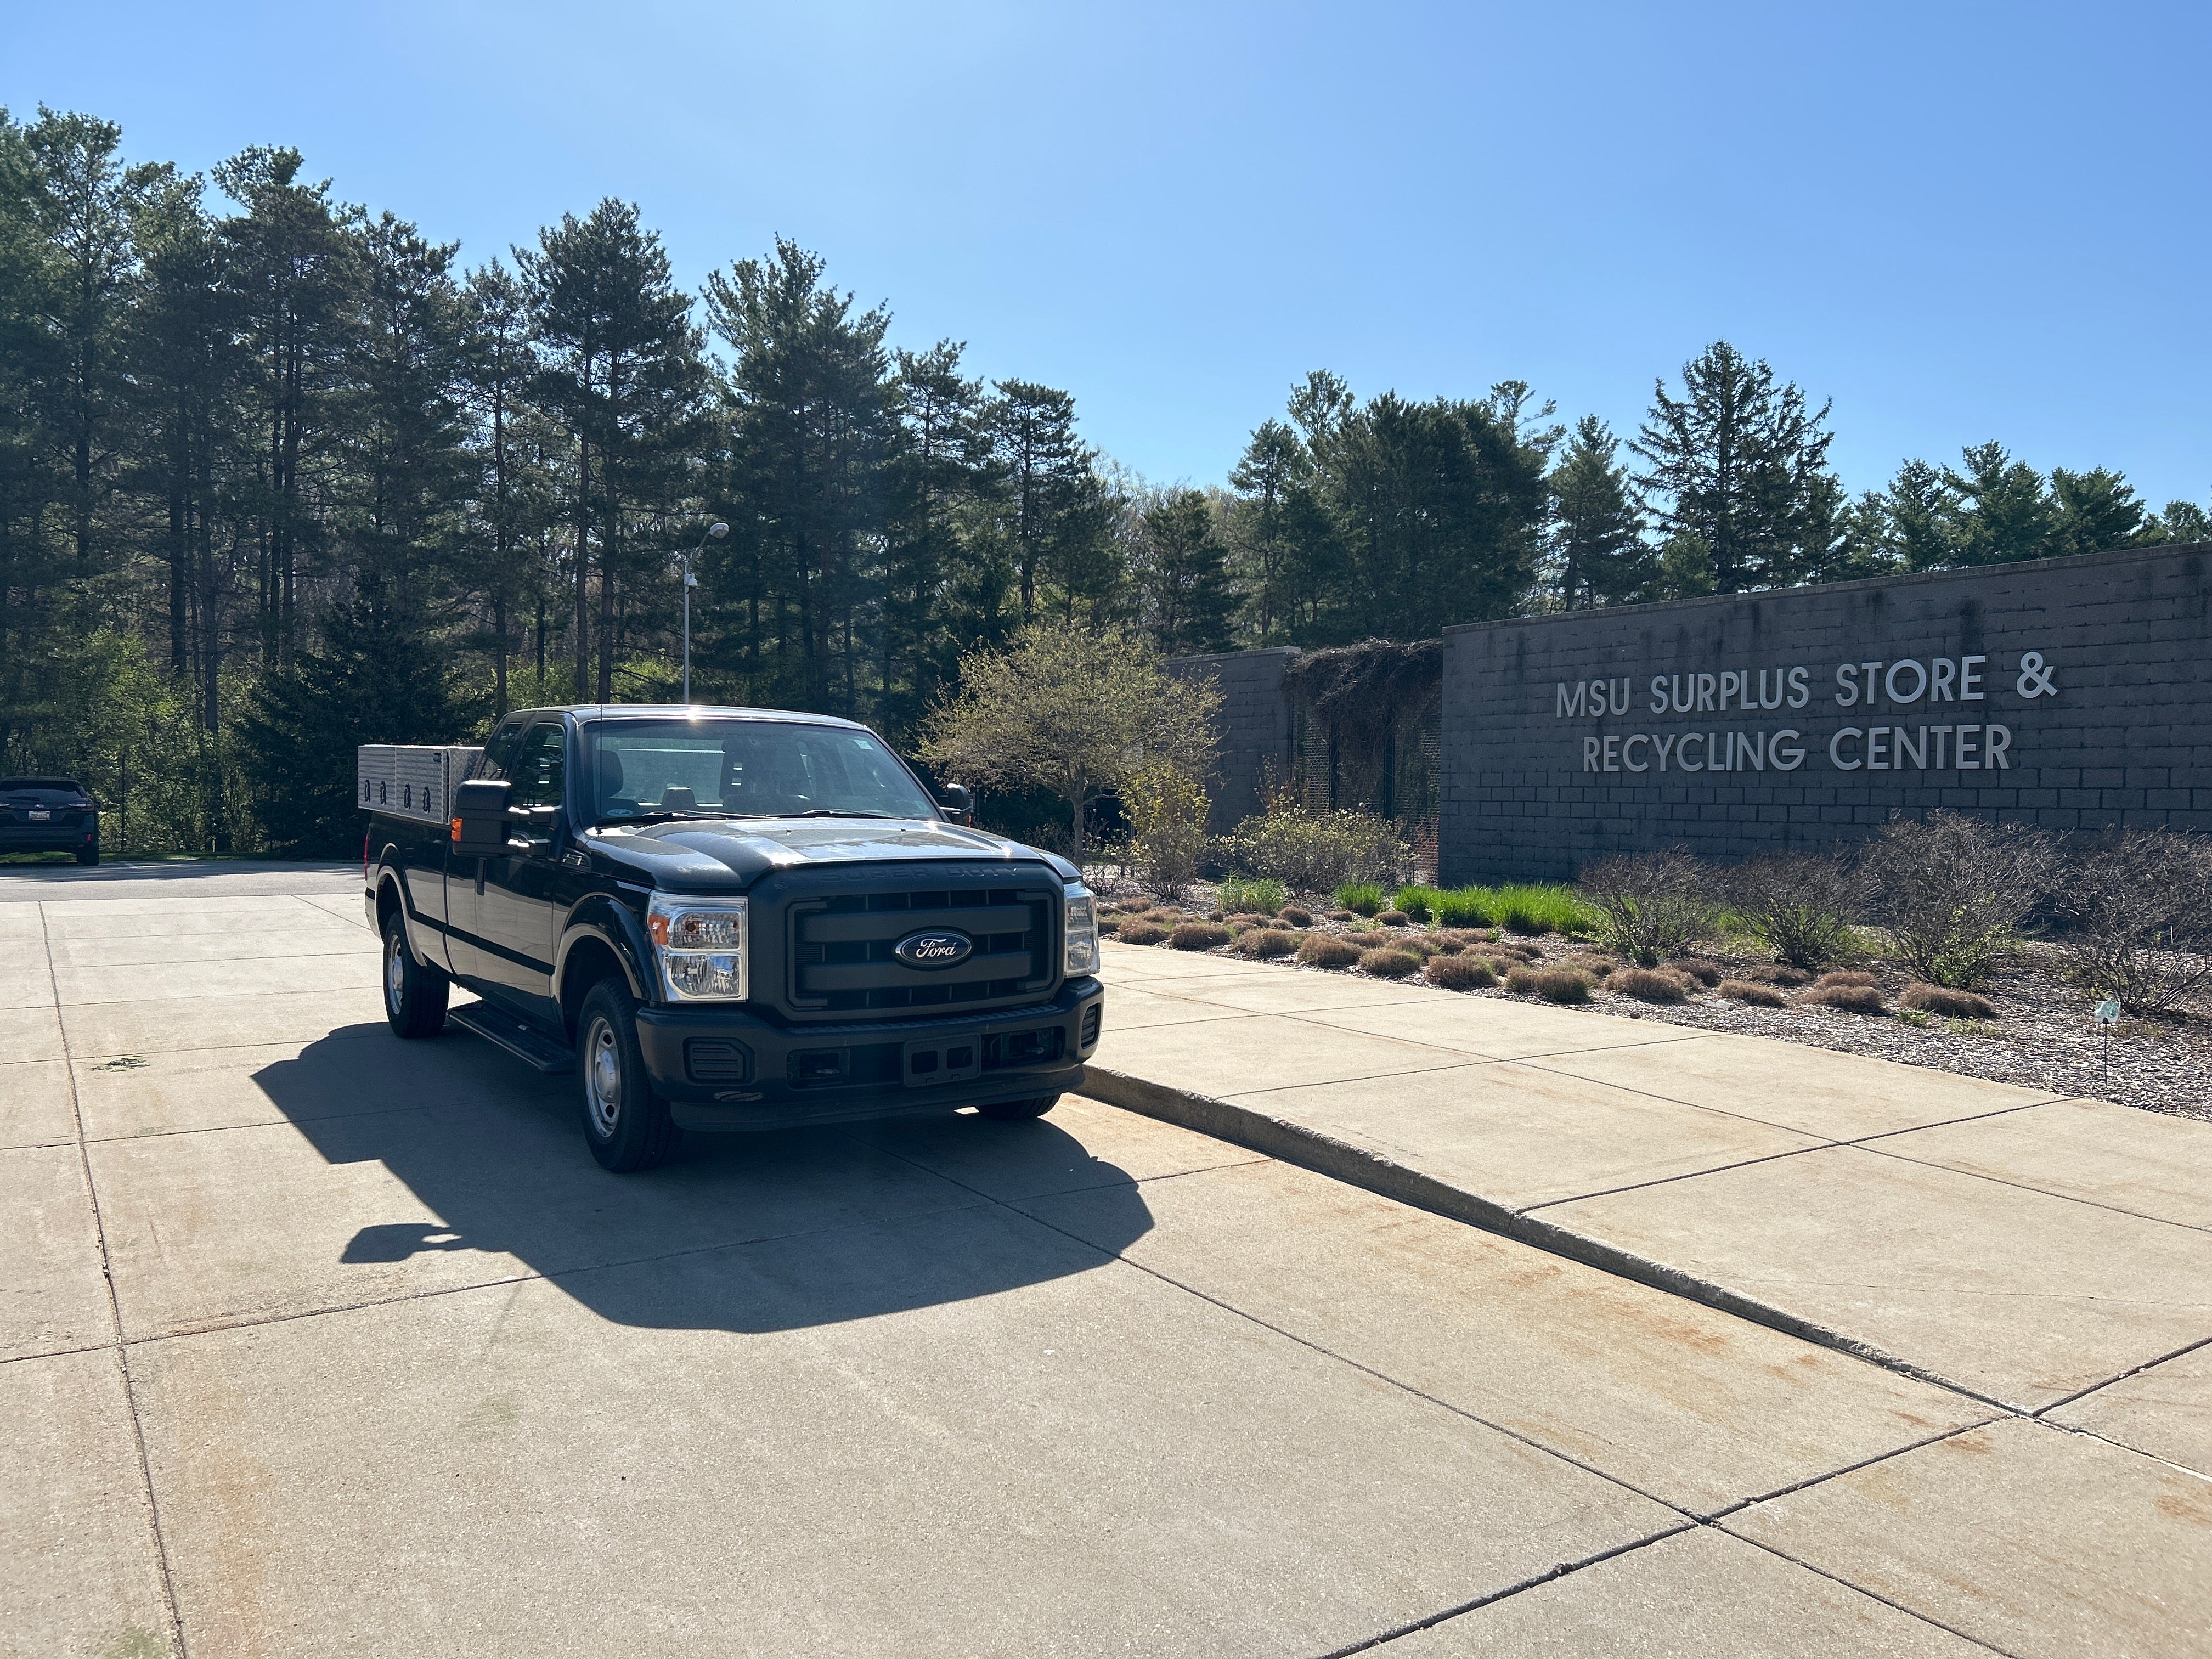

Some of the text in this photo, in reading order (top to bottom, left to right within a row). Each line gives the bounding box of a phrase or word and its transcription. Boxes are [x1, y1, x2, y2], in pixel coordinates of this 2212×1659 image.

[1556, 651, 2058, 718] MSU SURPLUS STORE &
[1583, 724, 2012, 772] RECYCLING CENTER
[820, 866, 1018, 882] SUPER DUTY
[916, 938, 957, 958] Ford
